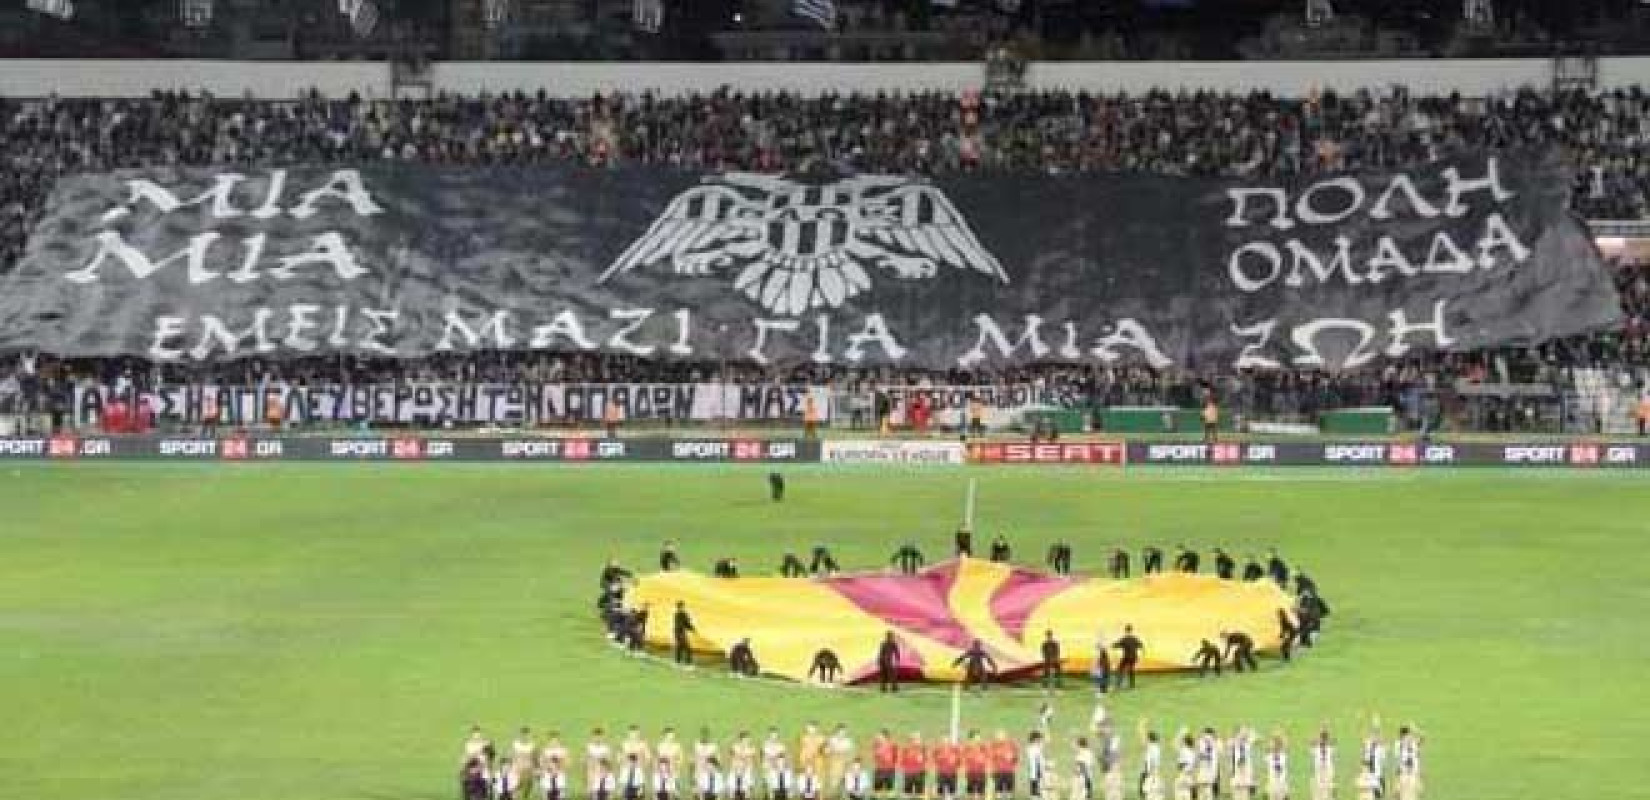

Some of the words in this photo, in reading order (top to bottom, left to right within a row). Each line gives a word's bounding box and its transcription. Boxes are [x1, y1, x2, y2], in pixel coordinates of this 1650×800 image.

[102, 168, 384, 221] ΜΙΑ
[1227, 157, 1514, 229] ΠΟΛΗ
[65, 230, 370, 283] ΜΙΑ
[1229, 213, 1531, 291] ΟΜΑΔΑ
[149, 304, 401, 361] ΕΜΕΙΣ
[435, 306, 693, 356] ΜΑΖΙ
[751, 312, 907, 365] ΓΙΑ
[957, 312, 1173, 367] ΜΙΑ
[1230, 298, 1456, 369] ΖΩΗ
[1004, 443, 1121, 460] SEAT
